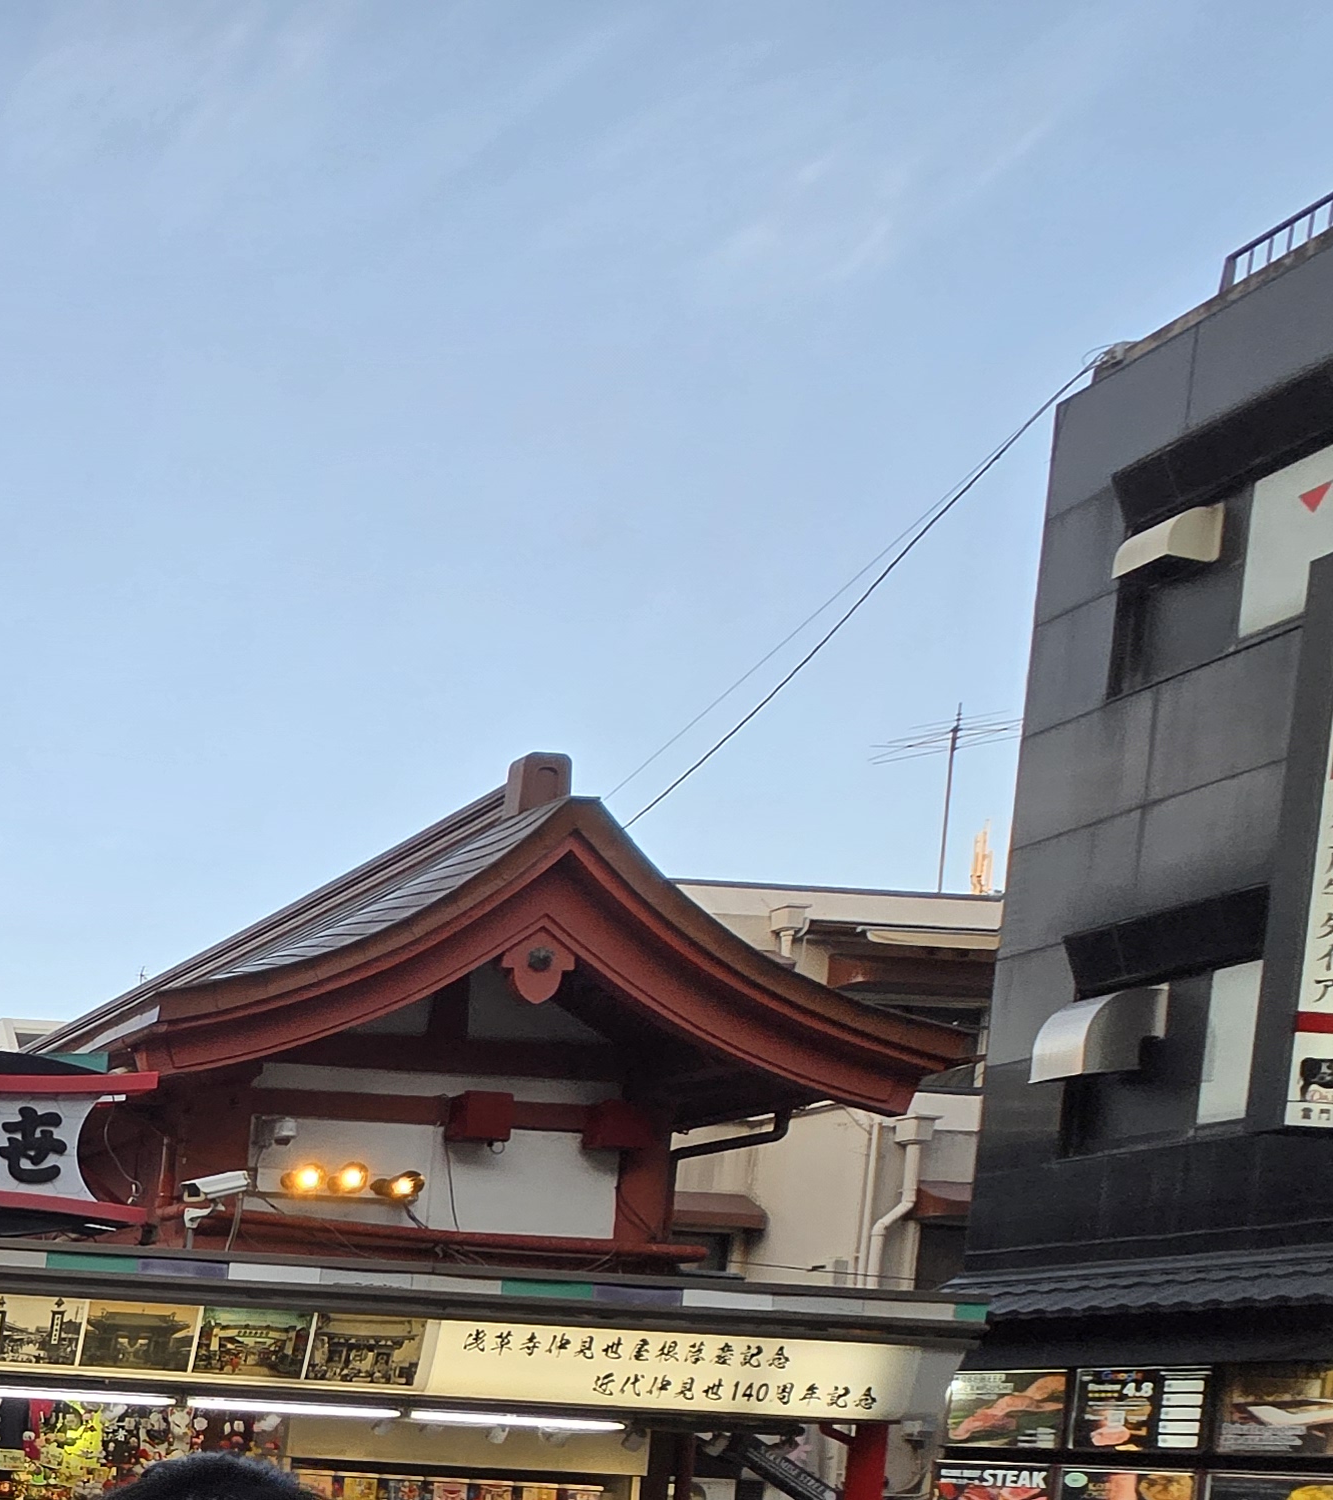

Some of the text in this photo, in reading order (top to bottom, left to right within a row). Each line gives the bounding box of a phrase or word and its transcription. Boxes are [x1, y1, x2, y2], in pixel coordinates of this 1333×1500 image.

[592, 1371, 878, 1410] 近代仲見世140周年記念
[1122, 1382, 1154, 1397] 4.8
[982, 1470, 1048, 1488] STEAK
